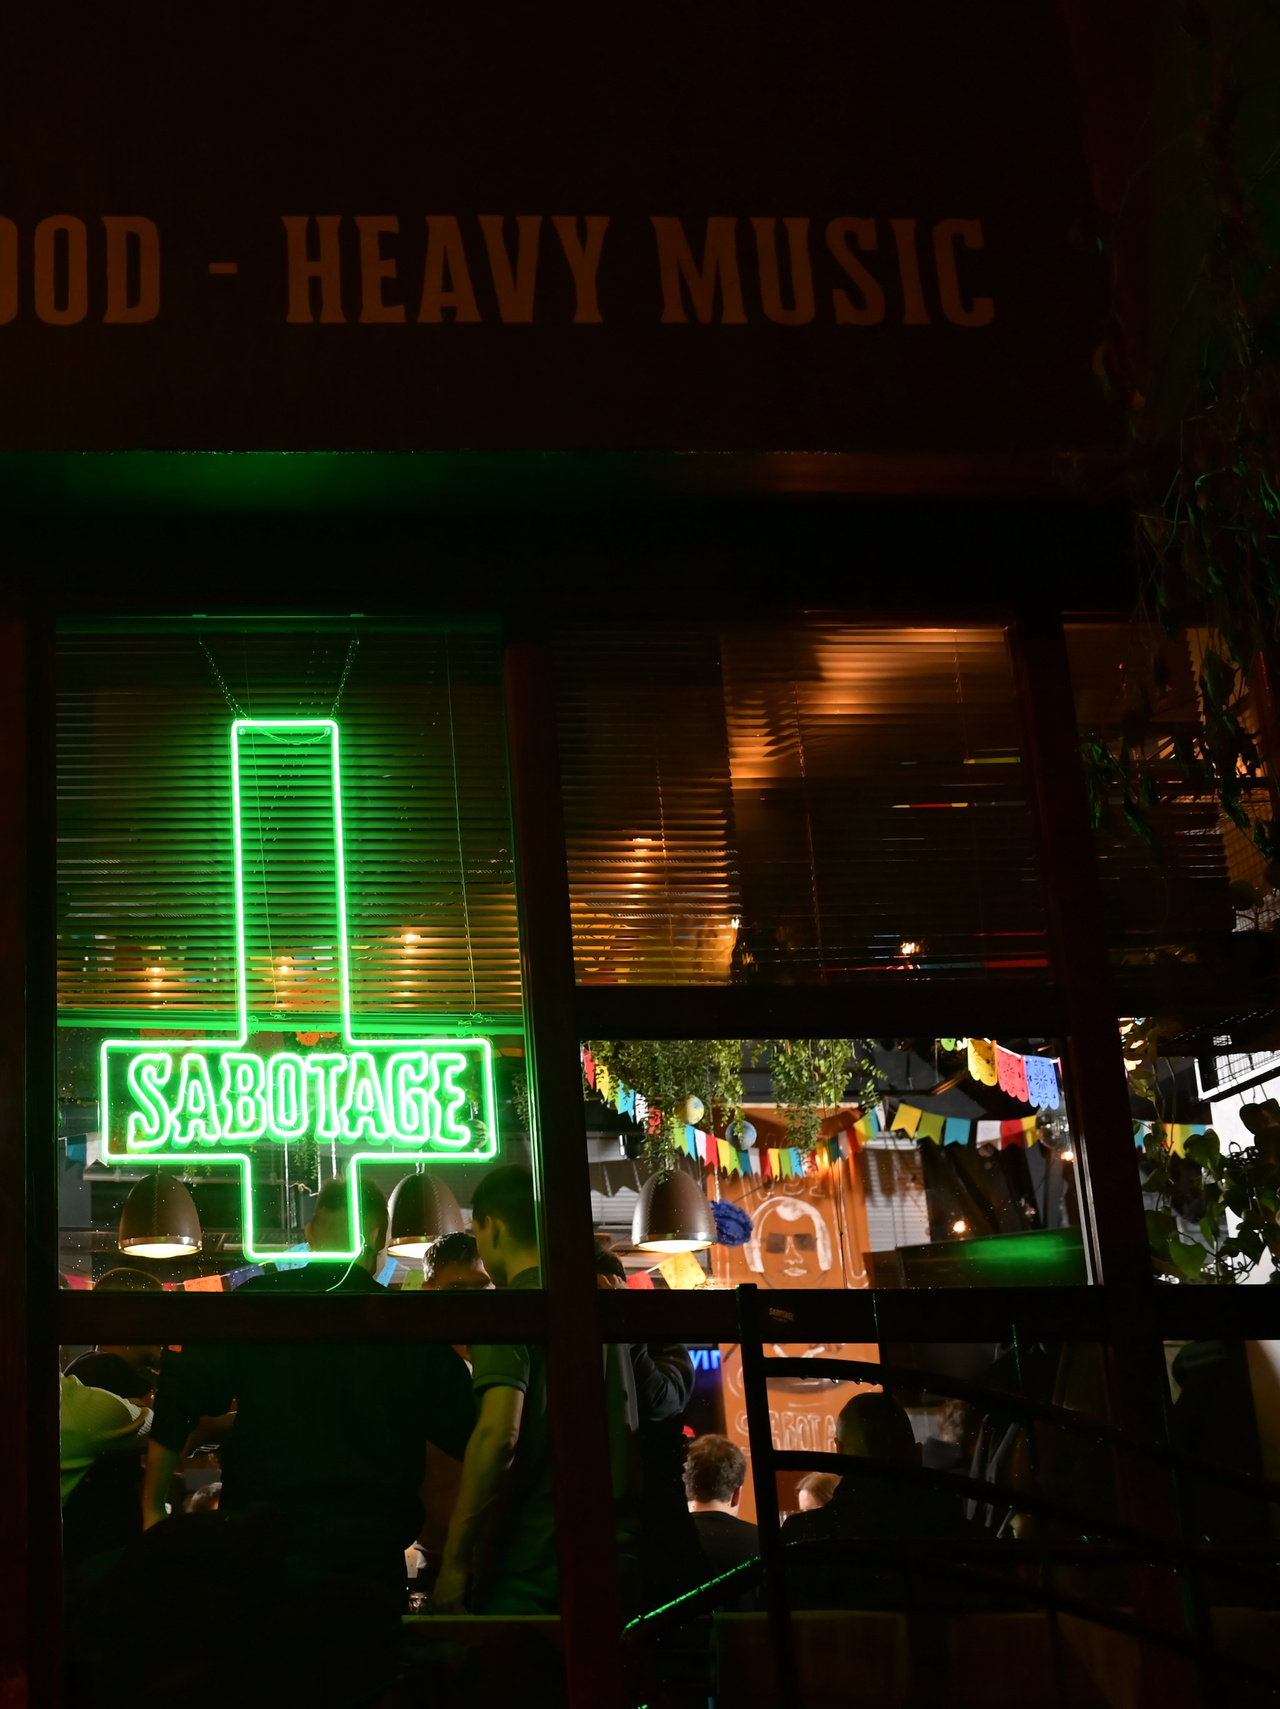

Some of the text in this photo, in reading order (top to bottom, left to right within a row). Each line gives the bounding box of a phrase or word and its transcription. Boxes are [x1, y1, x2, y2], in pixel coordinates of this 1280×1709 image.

[282, 215, 610, 325] HEAVY
[651, 215, 995, 327] MUSIC
[127, 1052, 472, 1149] SABOTAGE
